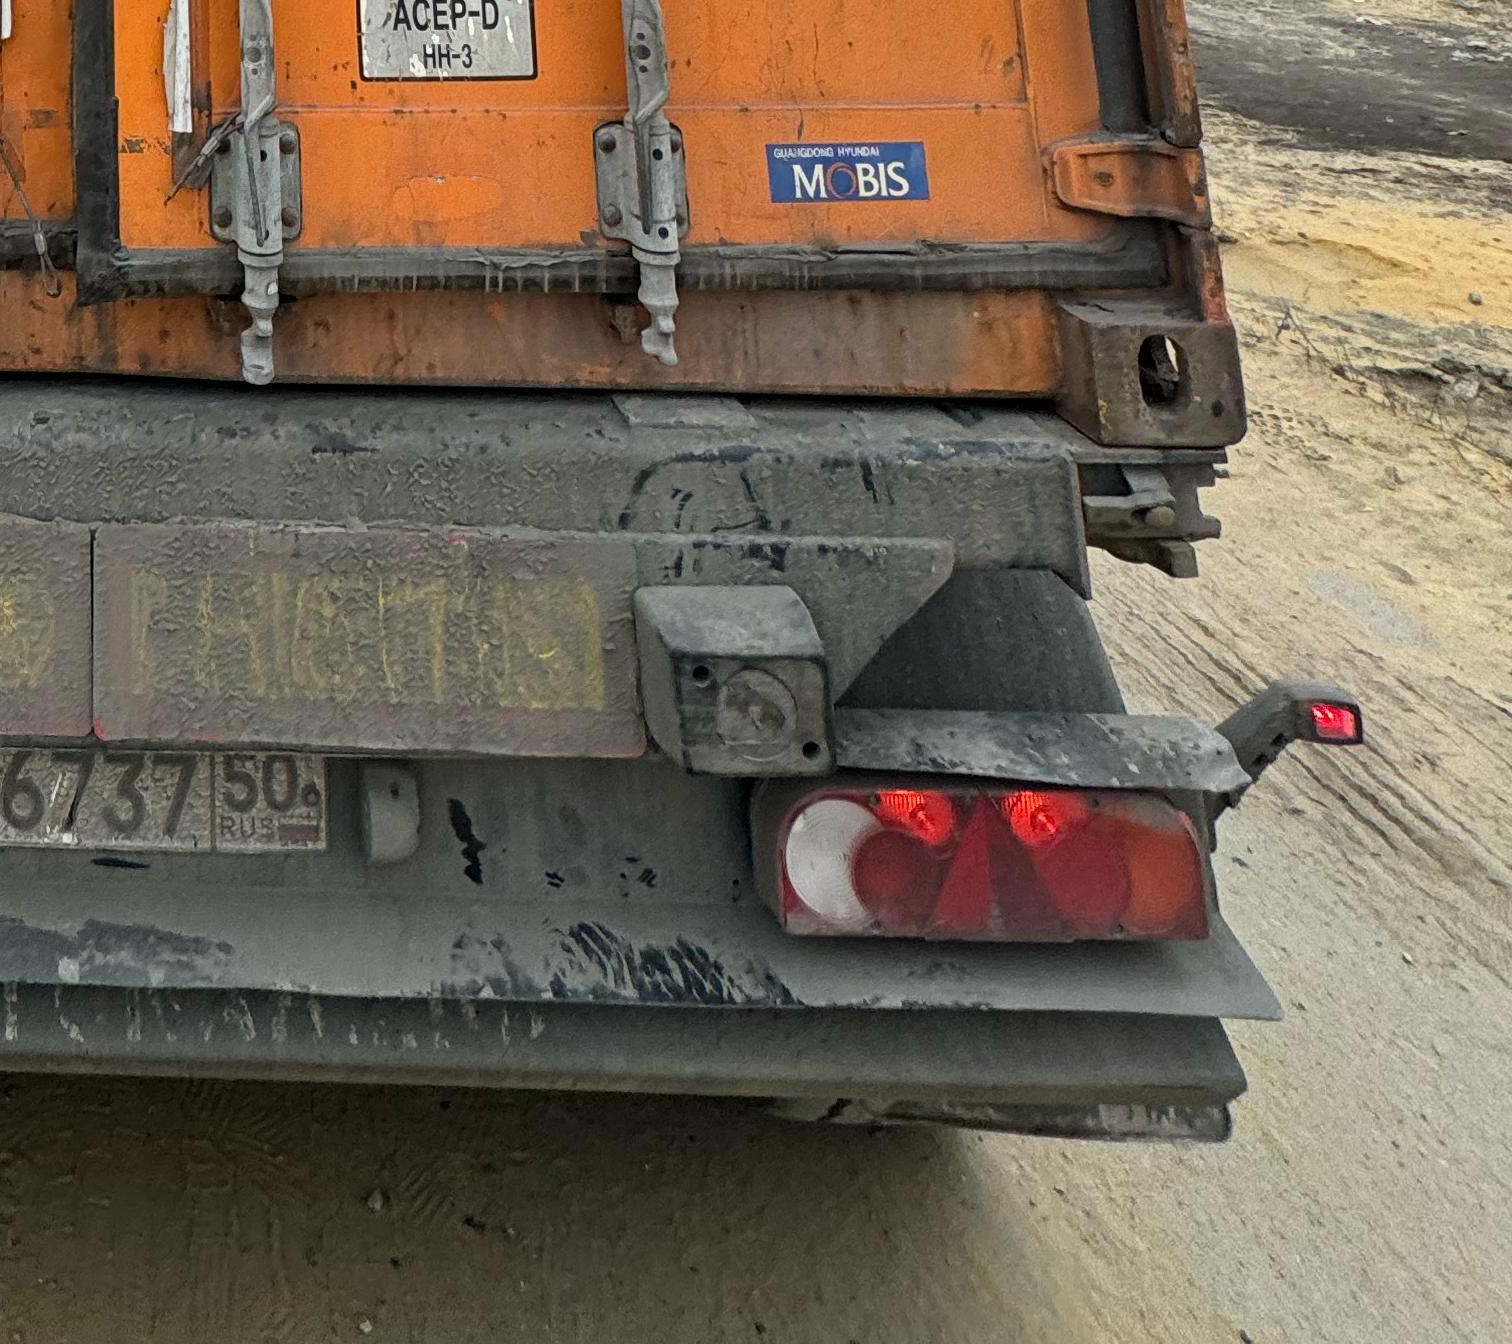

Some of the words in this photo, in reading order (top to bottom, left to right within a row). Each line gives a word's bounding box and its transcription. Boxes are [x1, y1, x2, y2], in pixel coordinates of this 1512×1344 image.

[422, 43, 473, 69] HH-3
[837, 145, 881, 157] HYUNDAI
[791, 161, 911, 200] MOBIS
[220, 816, 276, 840] RUS
